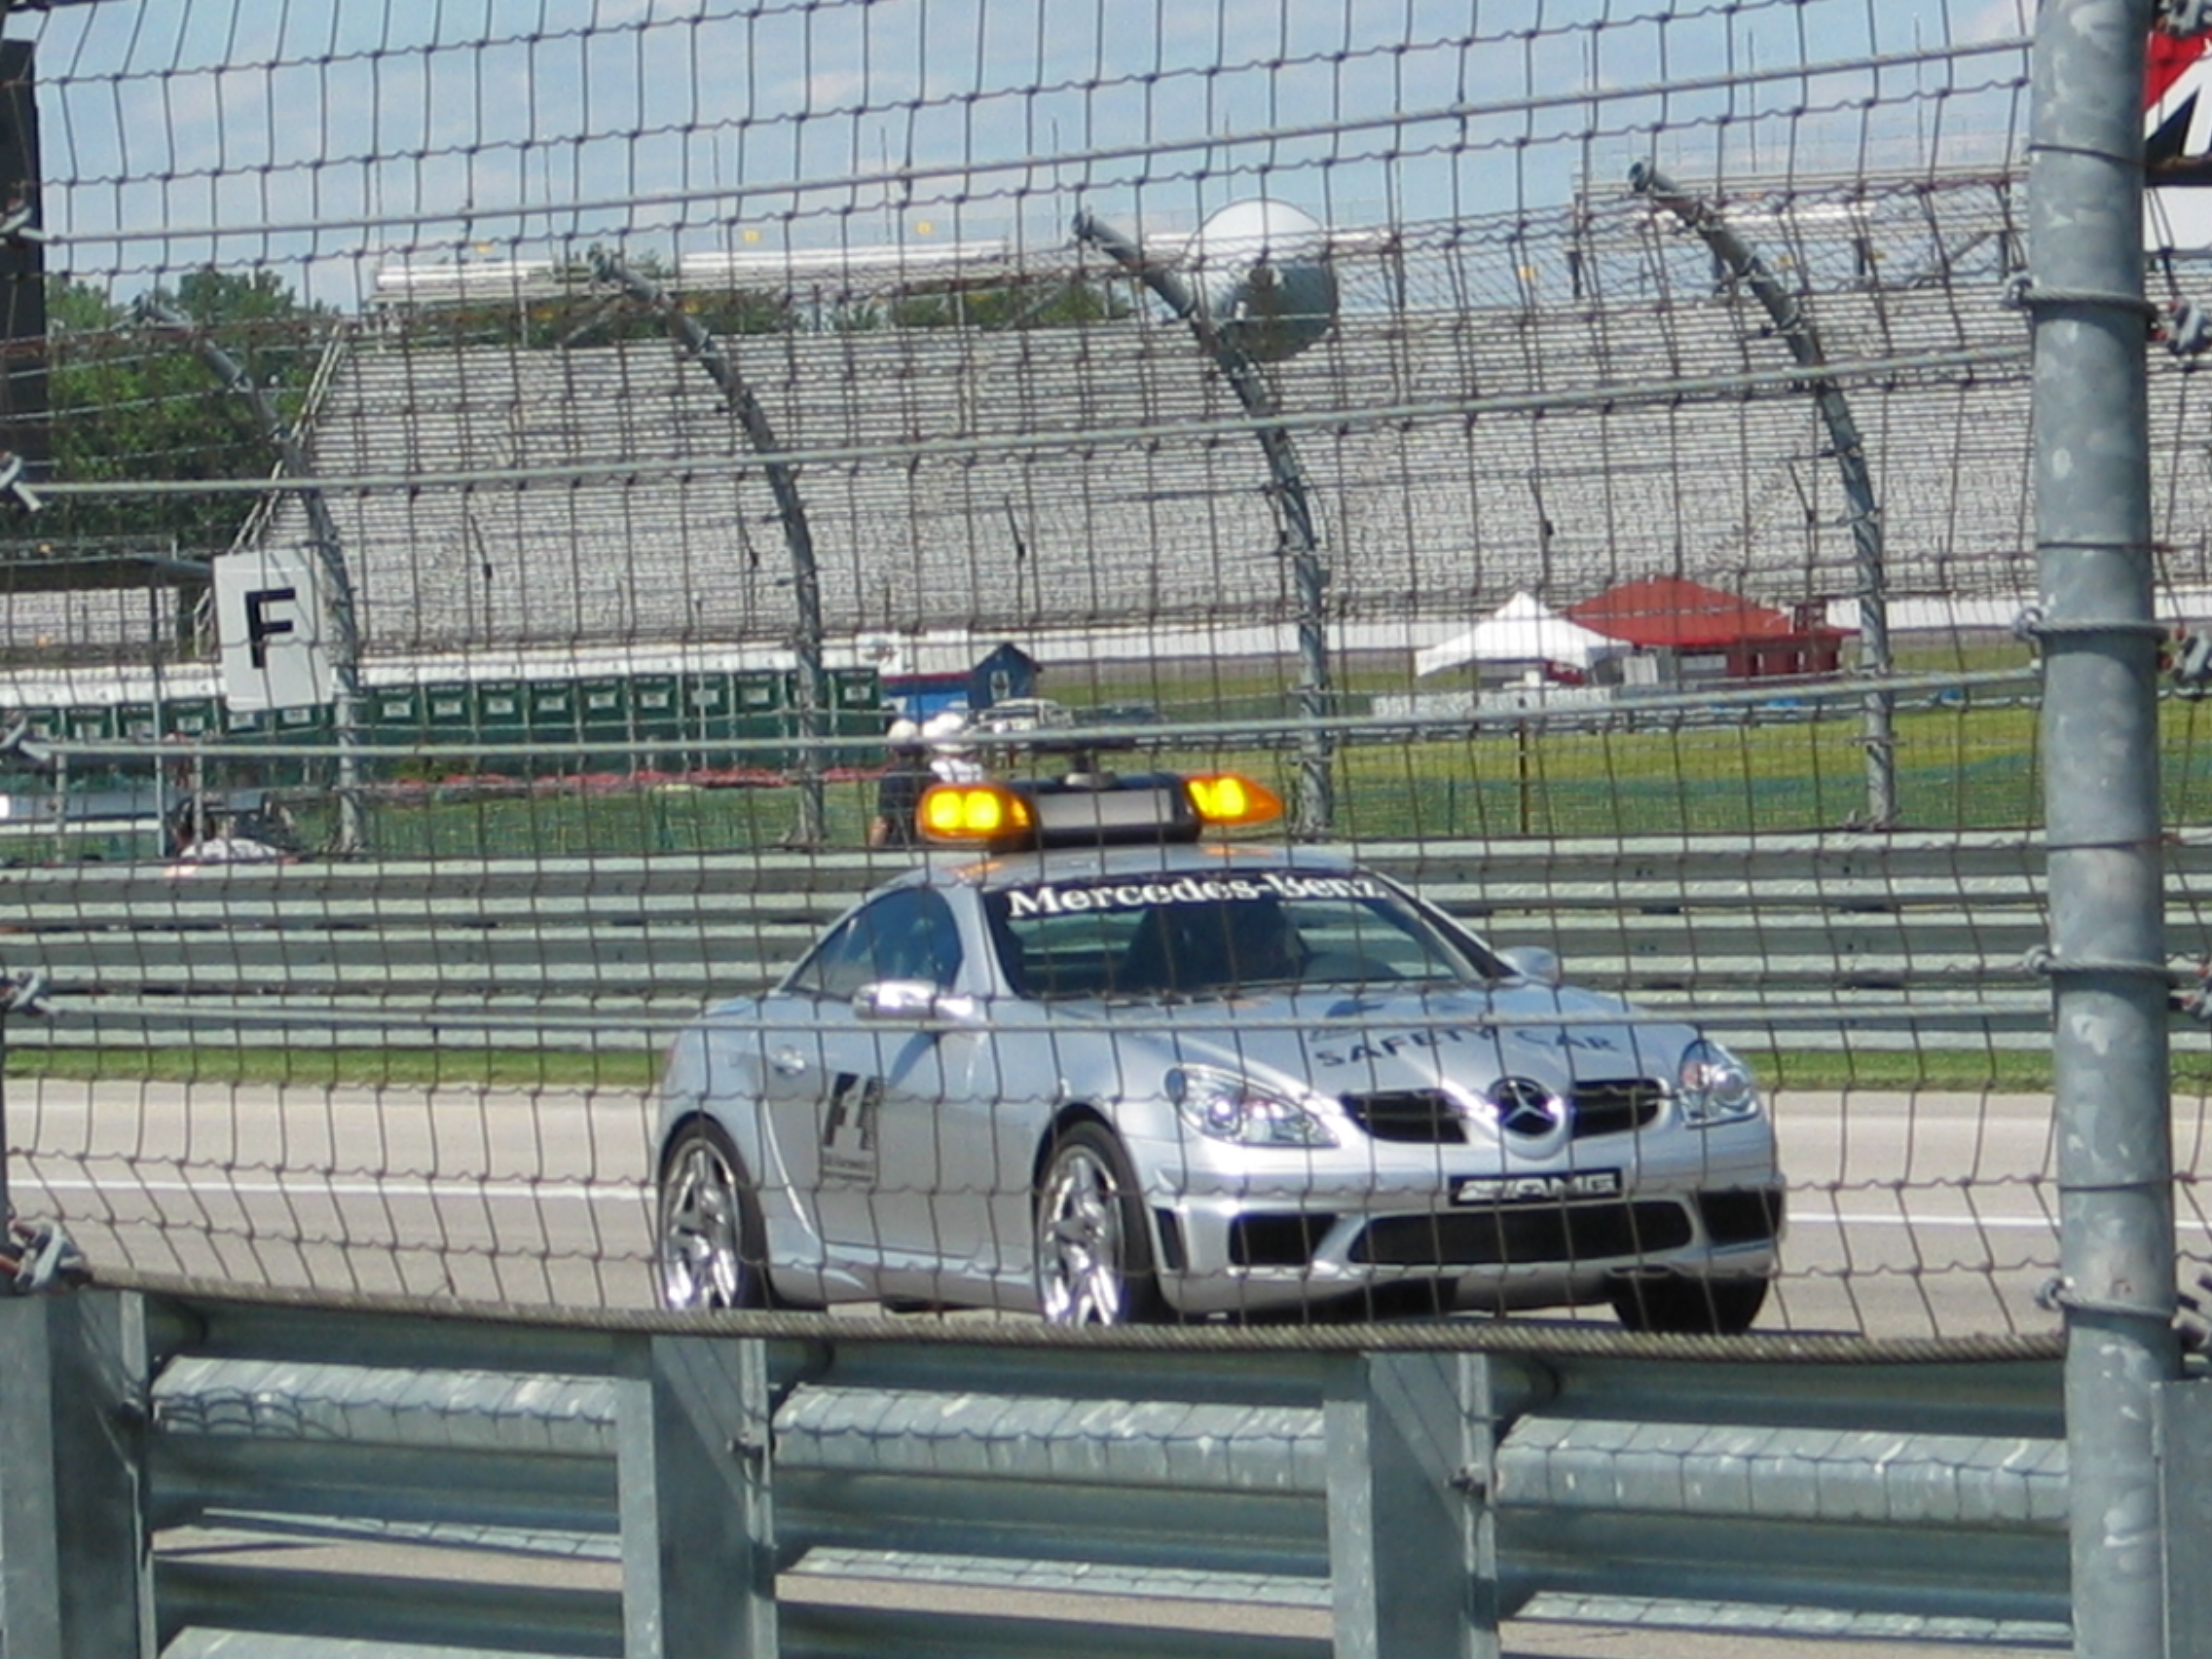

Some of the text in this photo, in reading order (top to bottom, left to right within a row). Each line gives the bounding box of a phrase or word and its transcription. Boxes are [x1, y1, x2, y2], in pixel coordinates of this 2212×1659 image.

[244, 587, 296, 669] F
[1006, 871, 1388, 918] Mercedes-Benz
[1314, 1025, 1620, 1068] SAFETY CAR
[1514, 1172, 1616, 1199] AMG
